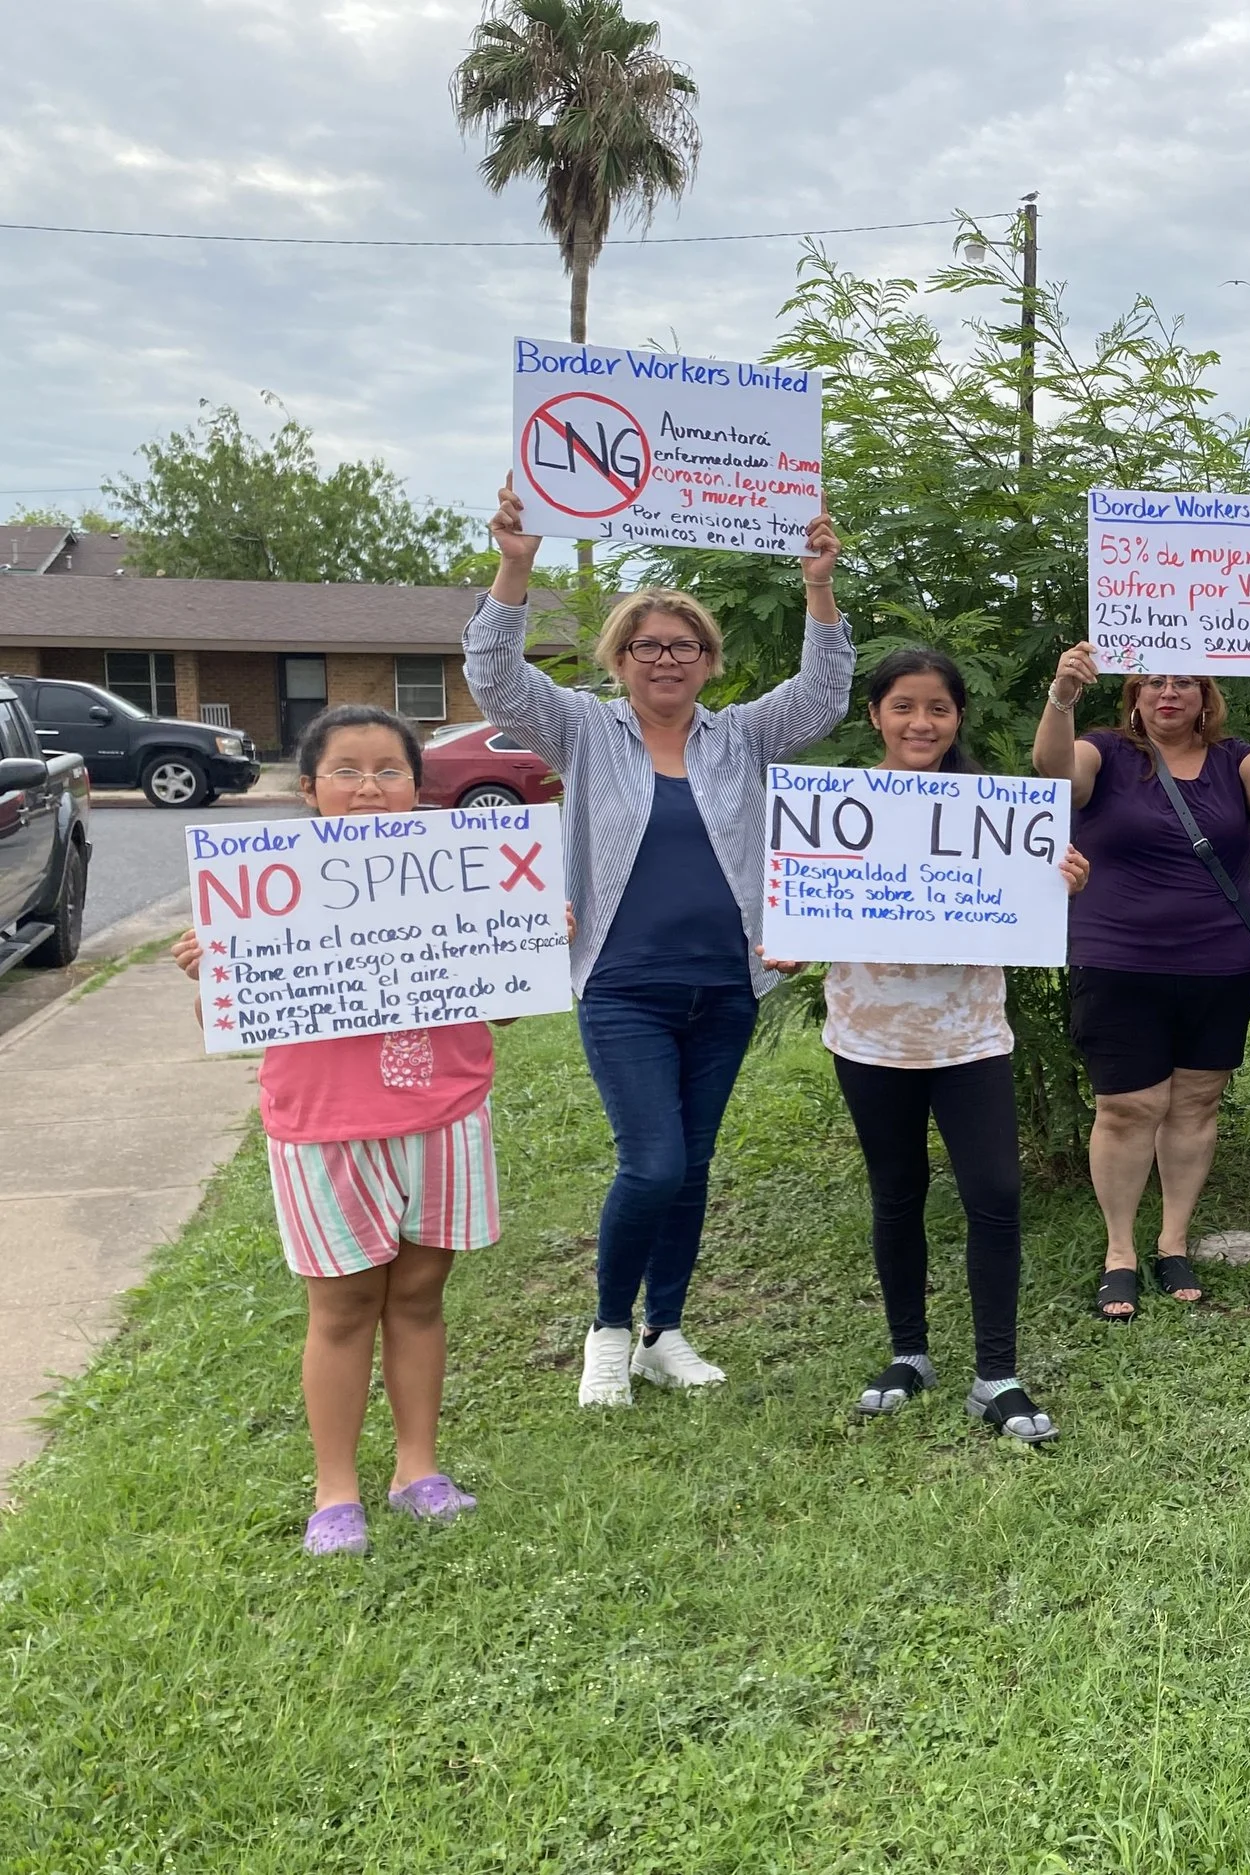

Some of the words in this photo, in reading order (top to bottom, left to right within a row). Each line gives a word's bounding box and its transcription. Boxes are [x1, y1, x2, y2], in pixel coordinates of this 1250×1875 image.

[516, 340, 622, 376] Border
[627, 350, 730, 386] Workers
[738, 364, 808, 393] United
[660, 411, 771, 446] Aumentará
[534, 419, 640, 488] LNG
[778, 452, 820, 474] Asma
[680, 488, 693, 508] y
[735, 471, 818, 497] leucemia
[628, 504, 661, 520] Por
[671, 512, 761, 530] emisiones
[767, 513, 810, 538] tóxic
[1090, 492, 1171, 519] Border
[1174, 495, 1250, 520] Workers
[600, 521, 613, 538] y
[708, 531, 725, 545] en
[731, 532, 745, 545] el
[1100, 534, 1149, 565] 53%
[1156, 541, 1184, 567] de
[1189, 581, 1229, 611] por
[1096, 602, 1142, 627] 25%
[1148, 606, 1187, 627] han
[1200, 608, 1249, 631] sido
[1098, 631, 1191, 651] acosadas
[769, 767, 854, 793] Border
[864, 770, 960, 798] Workers
[978, 776, 1057, 805] United
[187, 827, 300, 860] Border
[311, 817, 427, 843] Workers
[451, 808, 530, 832] United
[770, 794, 874, 851] NO
[930, 802, 1055, 865] LNG
[780, 858, 907, 888] Desigualdad
[920, 864, 982, 887] Social
[198, 863, 302, 926] NO
[785, 880, 854, 900] Efectos
[865, 885, 914, 902] sobre
[927, 886, 946, 904] la
[954, 888, 1002, 906] salud
[785, 899, 853, 920] Limita
[862, 904, 935, 922] nuestros
[944, 910, 1018, 924] recursos
[230, 927, 311, 959] Limita
[320, 924, 342, 948] el
[351, 924, 422, 946] acceso
[431, 924, 448, 937] a
[456, 913, 477, 934] la
[486, 909, 551, 937] playa
[227, 962, 286, 983] Pone
[293, 964, 318, 979] en
[324, 953, 394, 976] riesgo
[400, 950, 415, 963] a
[420, 936, 517, 961] diferentes
[520, 932, 569, 953] especies
[237, 978, 367, 1005] Contamina
[379, 968, 398, 987] el
[239, 1010, 270, 1028] No
[276, 995, 368, 1026] respeta
[380, 989, 401, 1008] lo
[407, 977, 496, 1010] sagrado
[505, 975, 531, 994] de
[332, 1009, 403, 1032] madre
